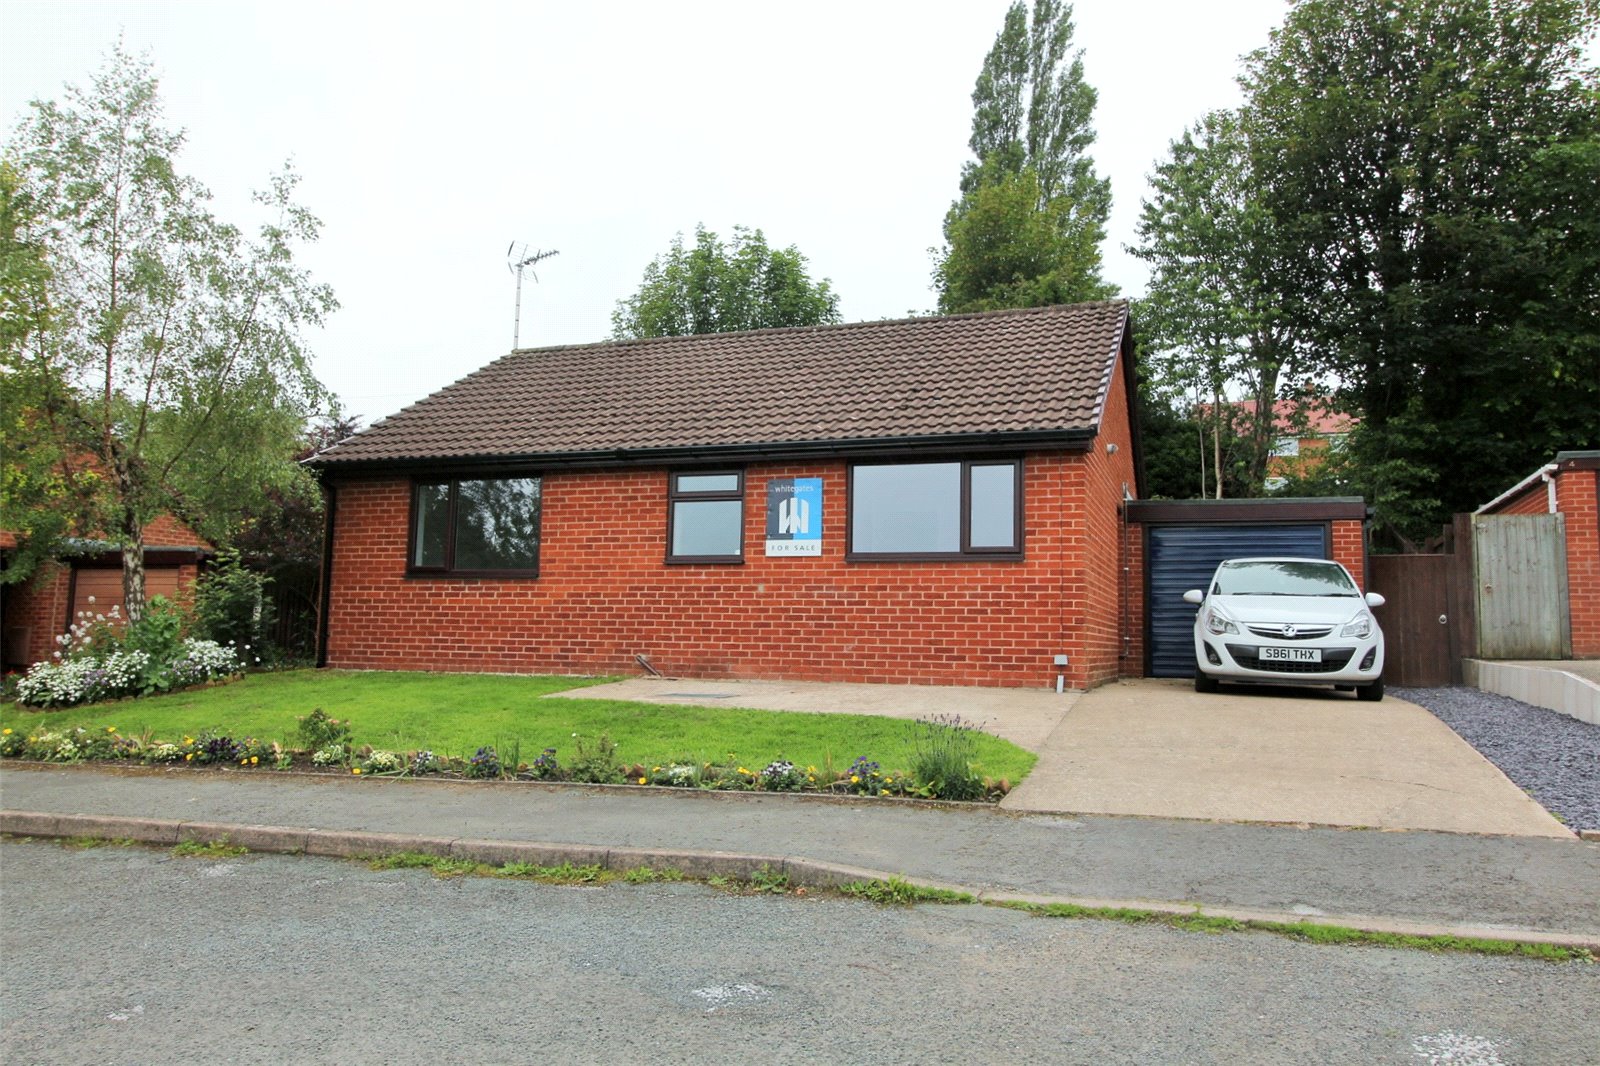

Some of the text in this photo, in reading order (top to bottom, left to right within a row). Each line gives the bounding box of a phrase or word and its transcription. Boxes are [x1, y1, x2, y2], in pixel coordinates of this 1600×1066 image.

[774, 485, 815, 494] whitegates
[771, 544, 816, 552] FOR SALE
[1265, 648, 1315, 660] SB61 THX
